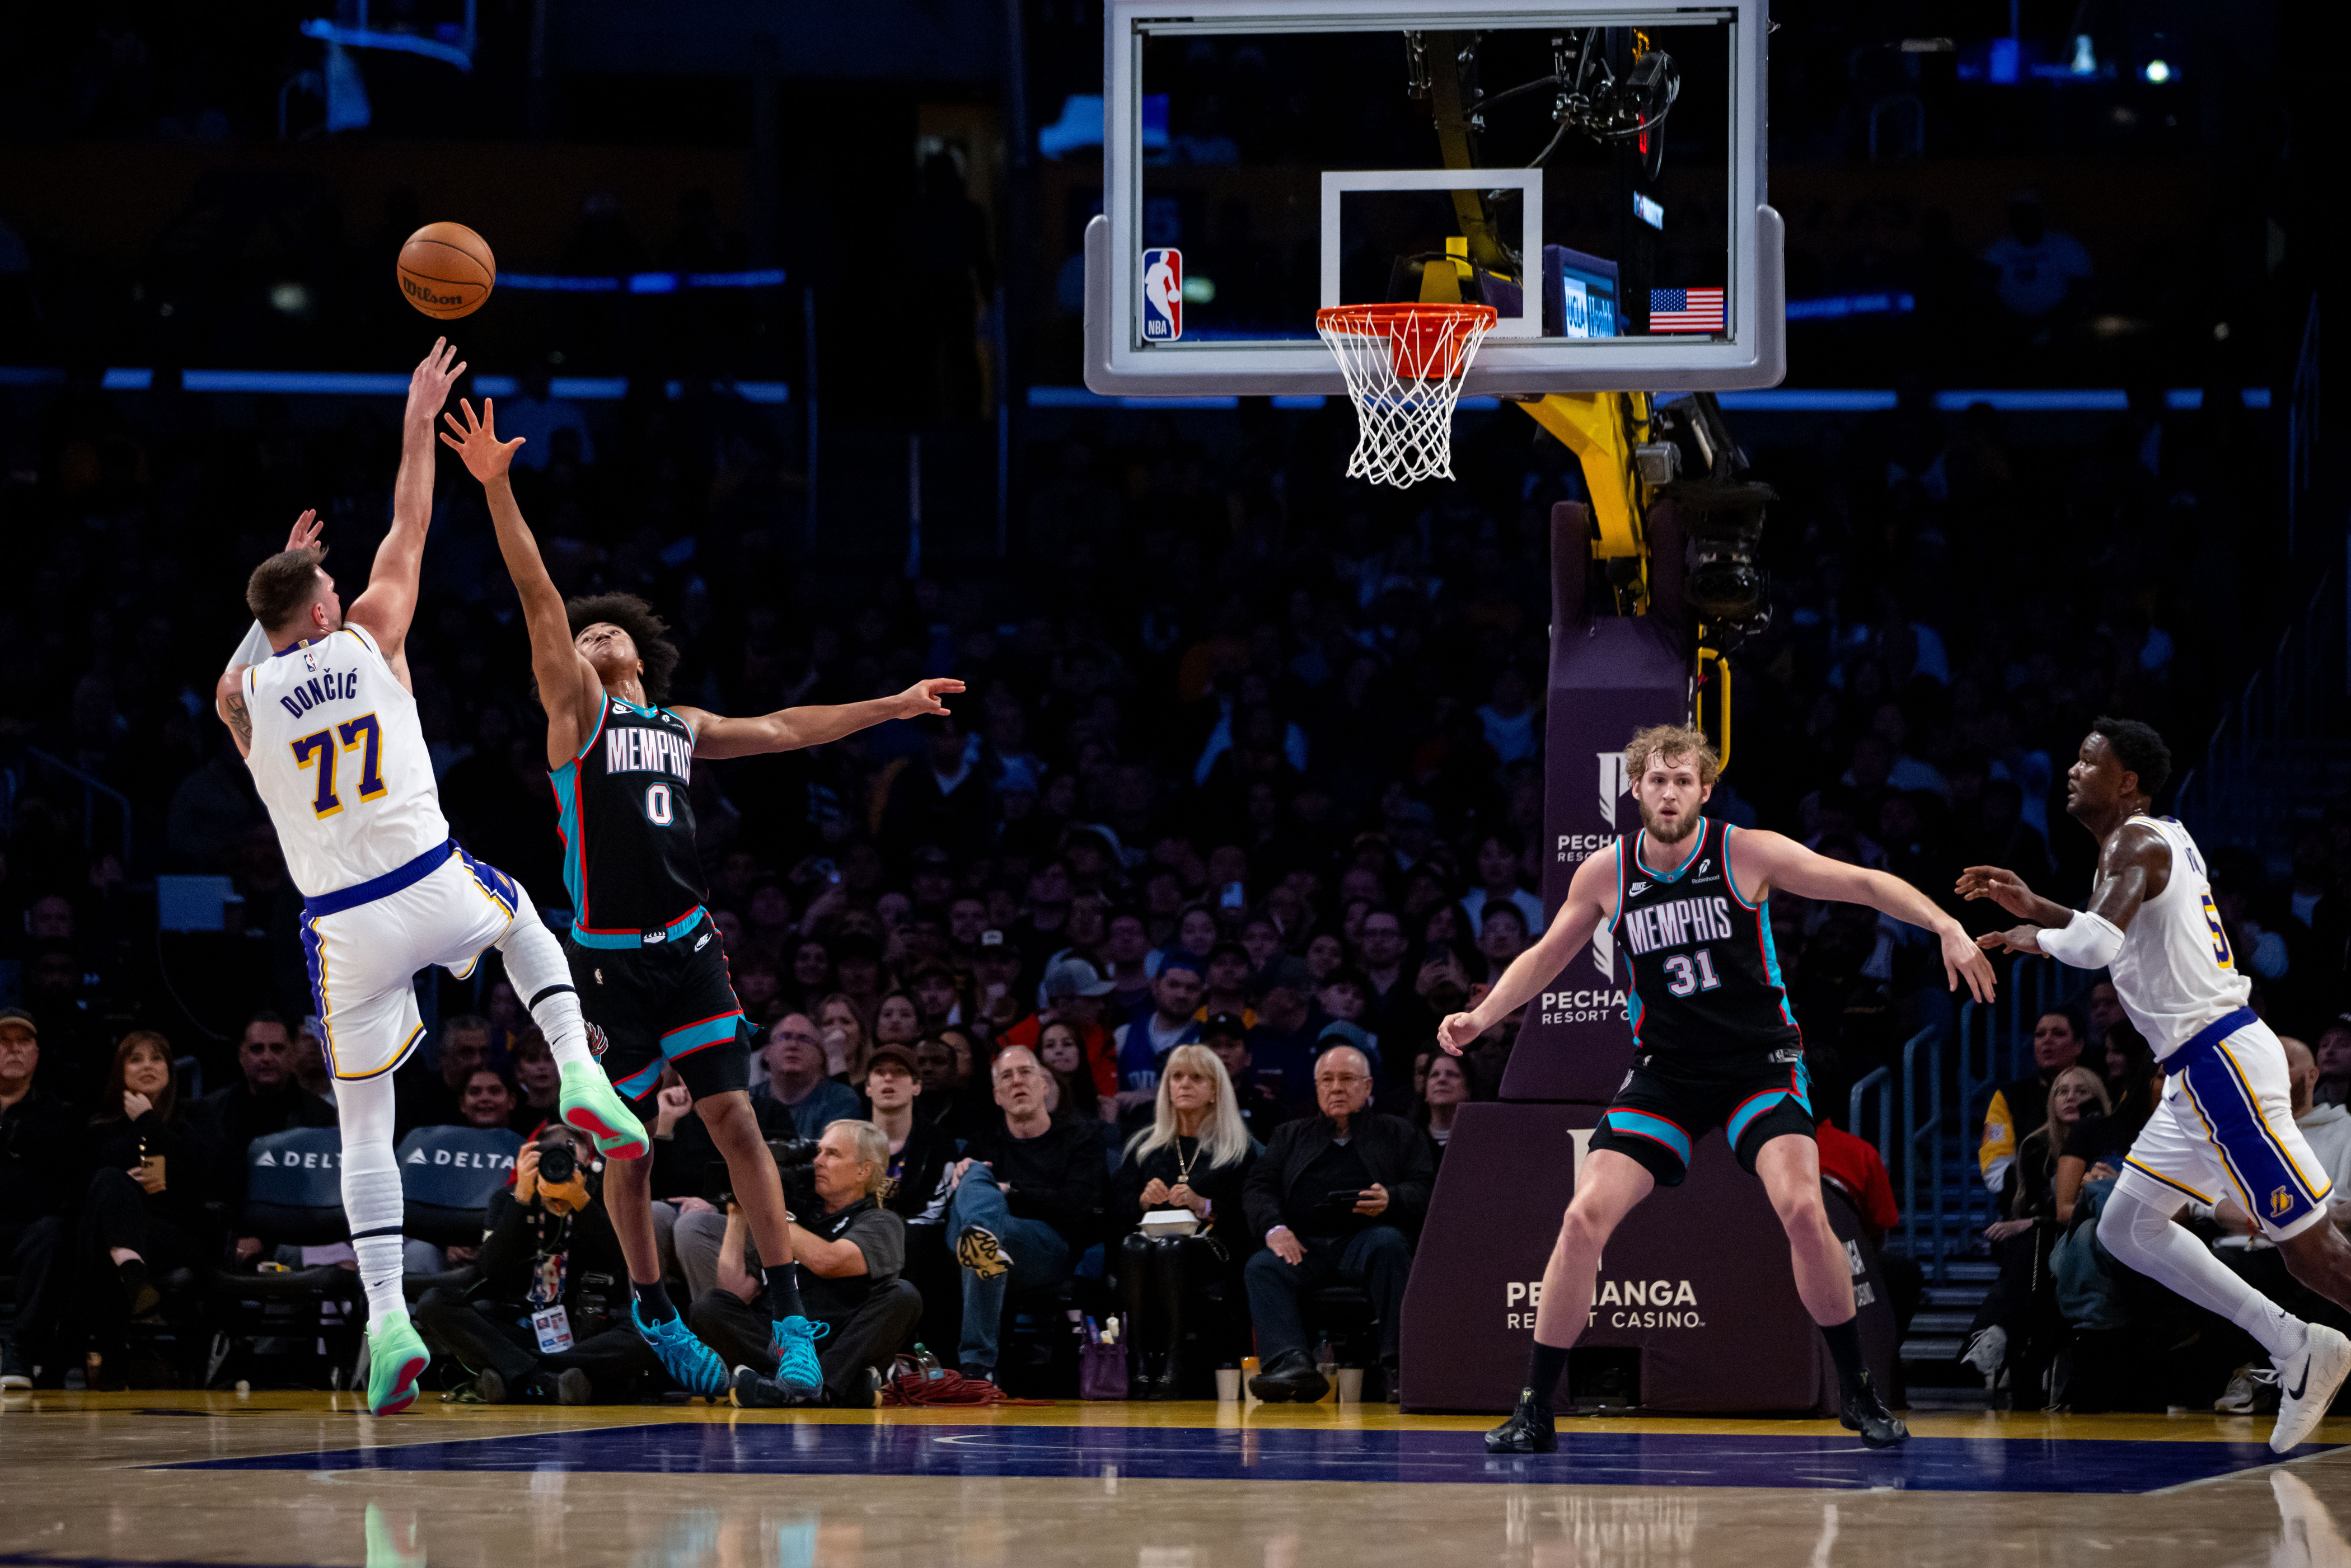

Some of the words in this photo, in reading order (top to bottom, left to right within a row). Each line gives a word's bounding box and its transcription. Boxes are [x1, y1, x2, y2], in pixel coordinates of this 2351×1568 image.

[403, 275, 462, 305] Wilson
[1148, 320, 1168, 335] NBA
[1567, 294, 1586, 330] UCLA
[1587, 295, 1615, 337] Health
[280, 668, 358, 719] DONČIĆ
[289, 711, 388, 820] 77
[645, 781, 674, 825] 0
[1631, 881, 1647, 891] NIKE
[1692, 874, 1720, 885] Robinhood
[1624, 896, 1732, 956] MEMPHIS
[2200, 894, 2232, 969] 5
[1662, 948, 1721, 998] 31
[1542, 989, 1628, 1011] PECHA
[1542, 1009, 1610, 1025] RESORT
[433, 1148, 515, 1169] DELTA
[1506, 1279, 1698, 1307] PEANGA
[1507, 1312, 1598, 1329] RET
[1611, 1311, 1699, 1328] CASINO
